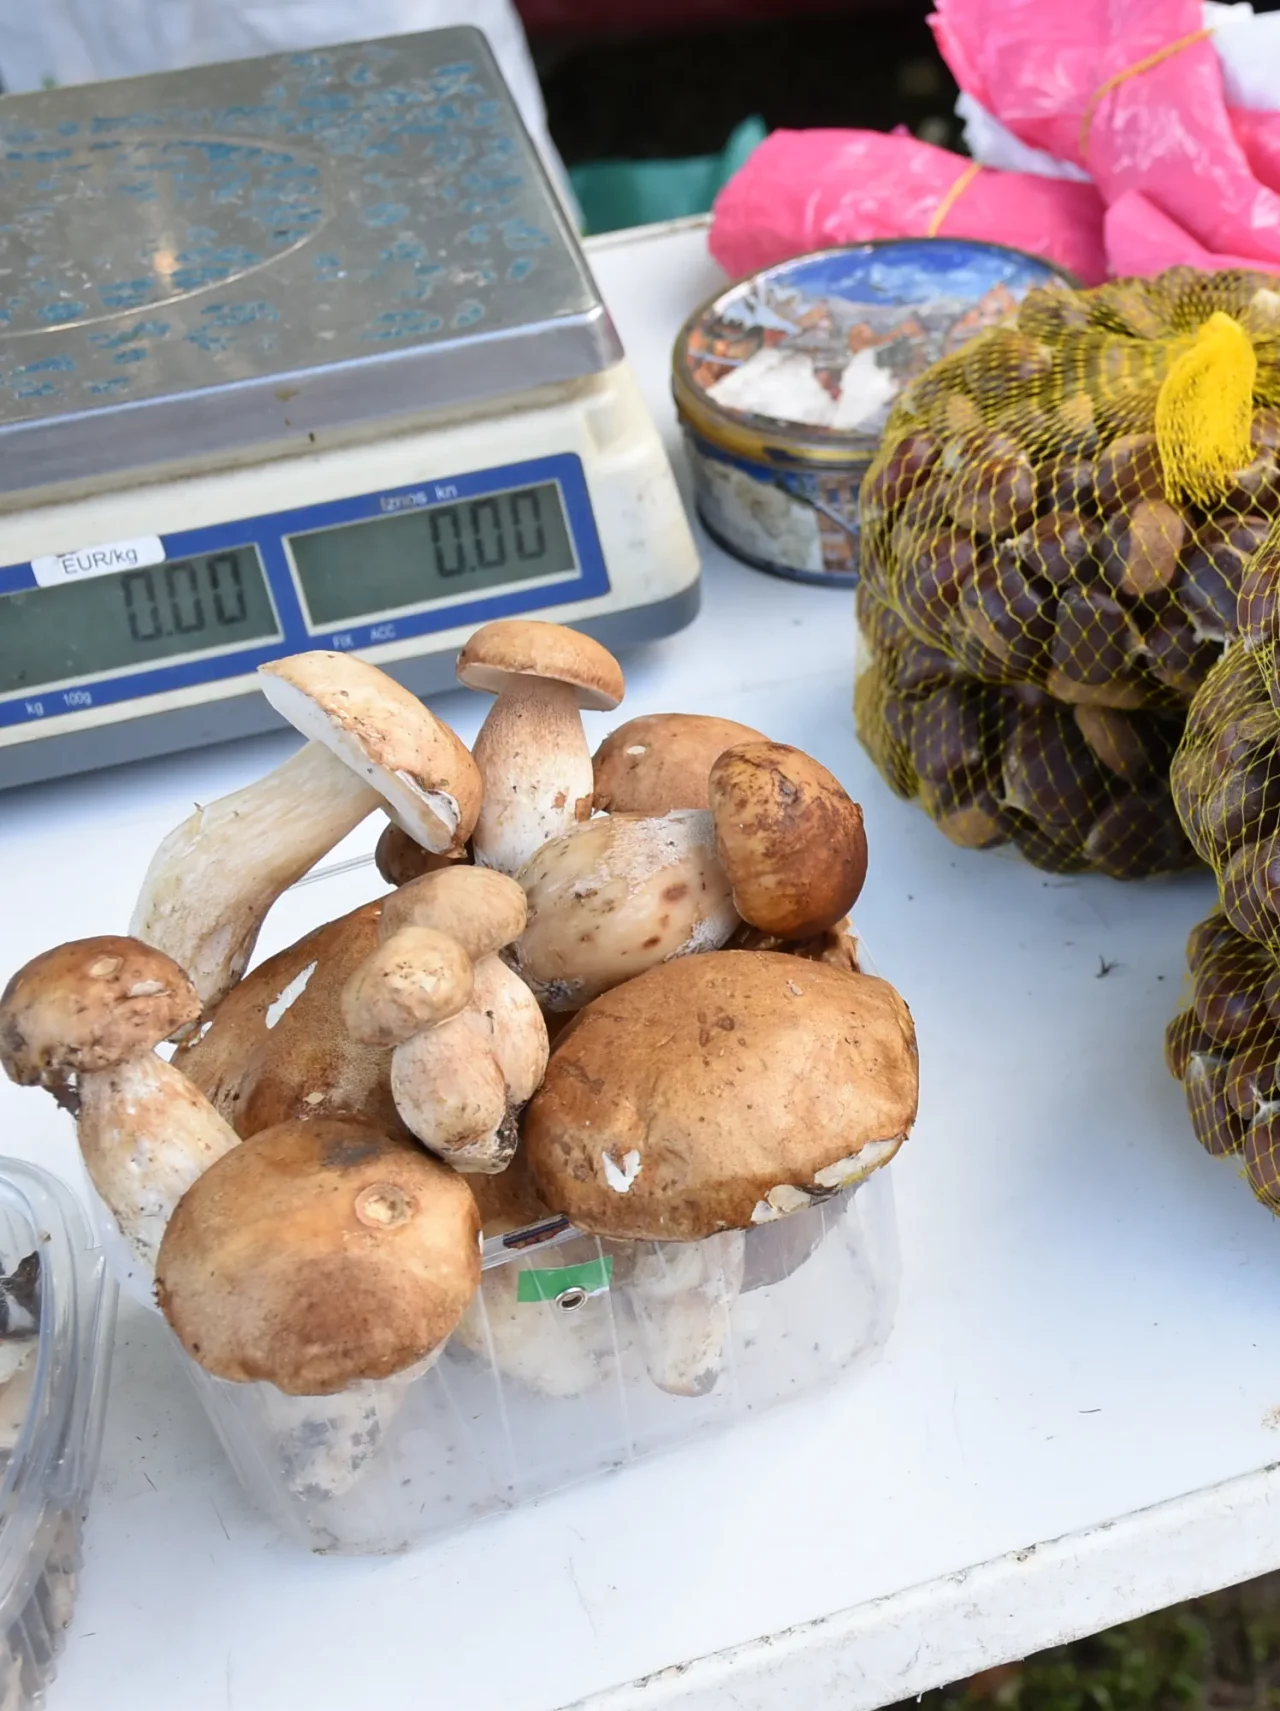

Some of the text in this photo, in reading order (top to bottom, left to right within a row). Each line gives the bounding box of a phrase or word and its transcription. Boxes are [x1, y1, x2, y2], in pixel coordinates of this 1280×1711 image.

[435, 485, 457, 500] kn
[429, 490, 545, 579] 0.00
[61, 548, 138, 575] EUR/kg
[120, 553, 247, 641] 0.00
[26, 691, 92, 716] kg 100g
